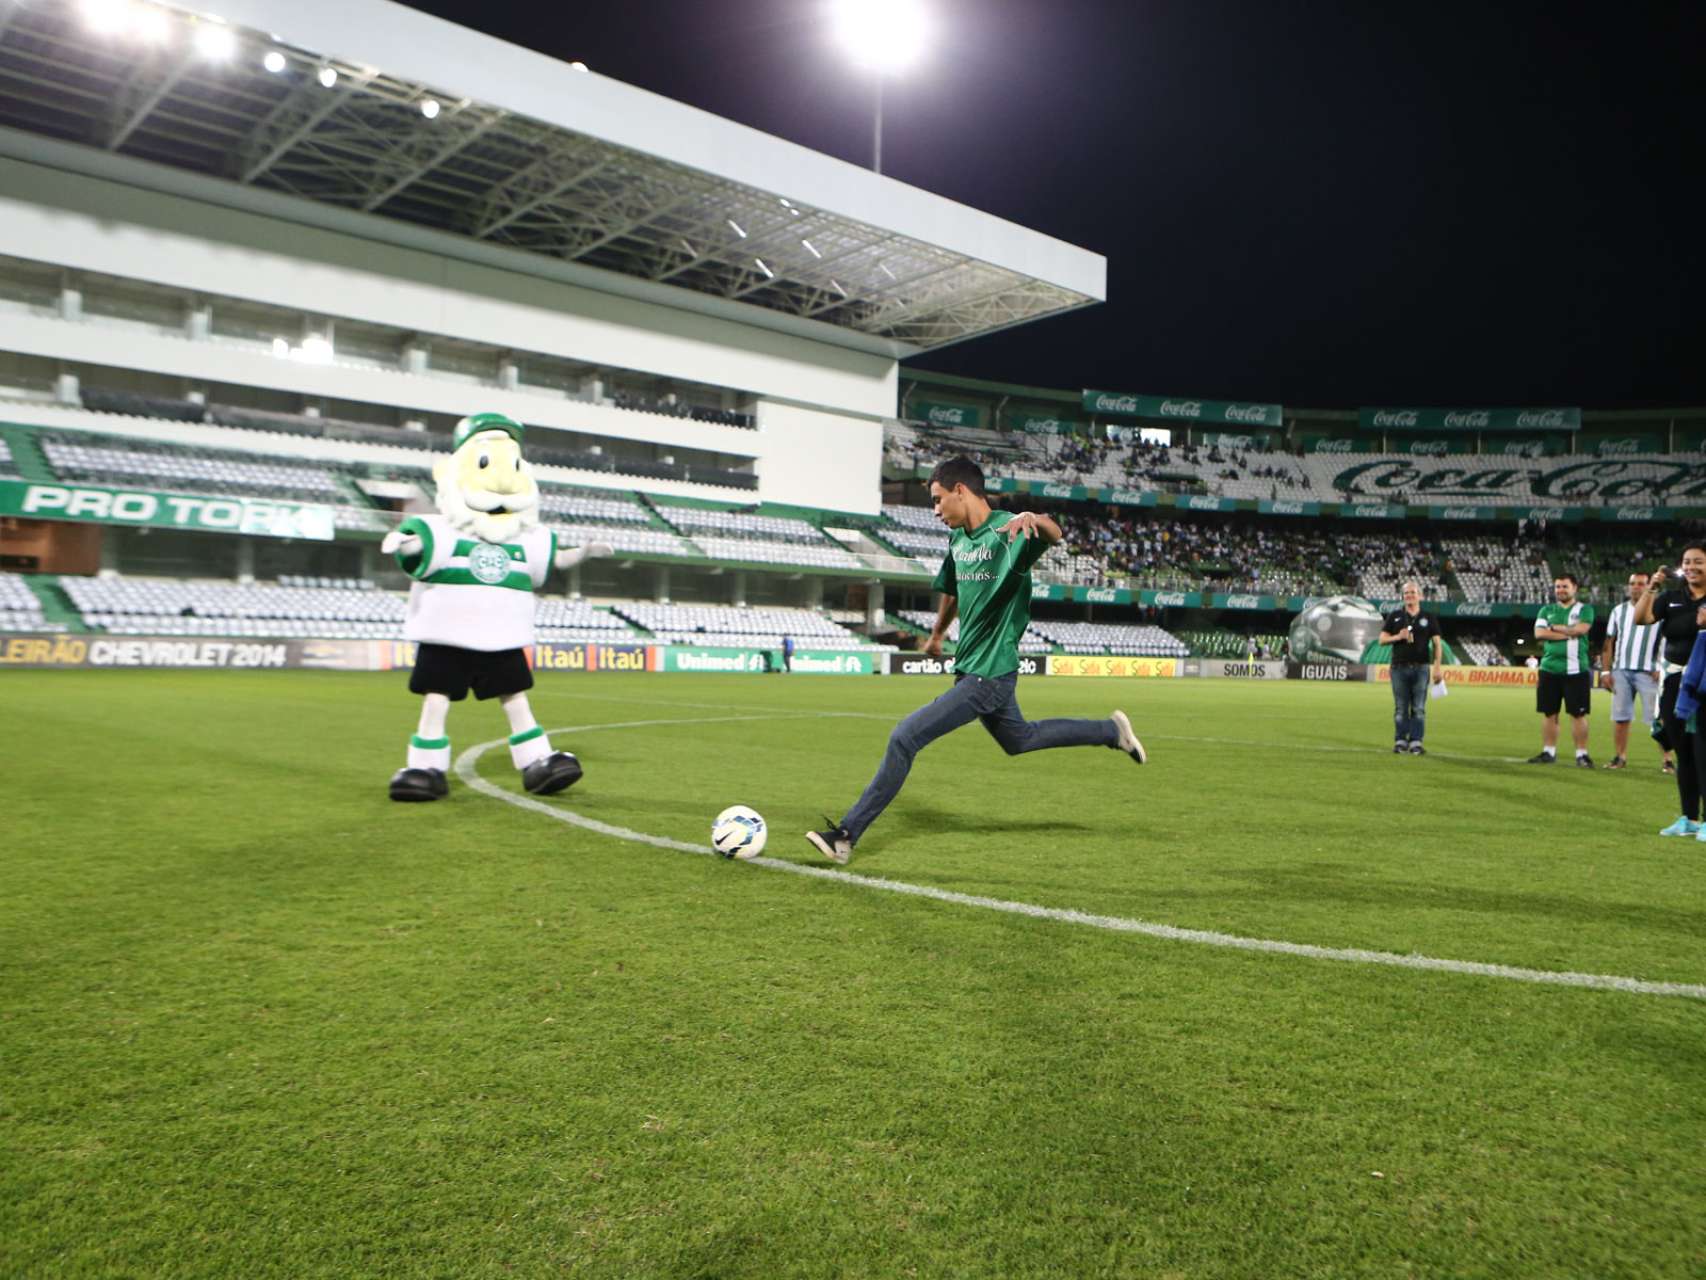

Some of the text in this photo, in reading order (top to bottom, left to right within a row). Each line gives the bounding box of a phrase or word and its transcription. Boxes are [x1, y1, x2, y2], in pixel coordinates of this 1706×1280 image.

[22, 485, 157, 521] PRO
[88, 640, 233, 666] CHEVROLET
[232, 644, 286, 667] 2014
[536, 646, 584, 669] Itaú
[600, 648, 644, 669] Itaú
[677, 652, 744, 671] Unimed
[902, 659, 942, 673] cartão
[1223, 664, 1266, 678] SOMOS
[1301, 665, 1347, 680] IGUAIS
[1468, 671, 1524, 684] BRAHMA
